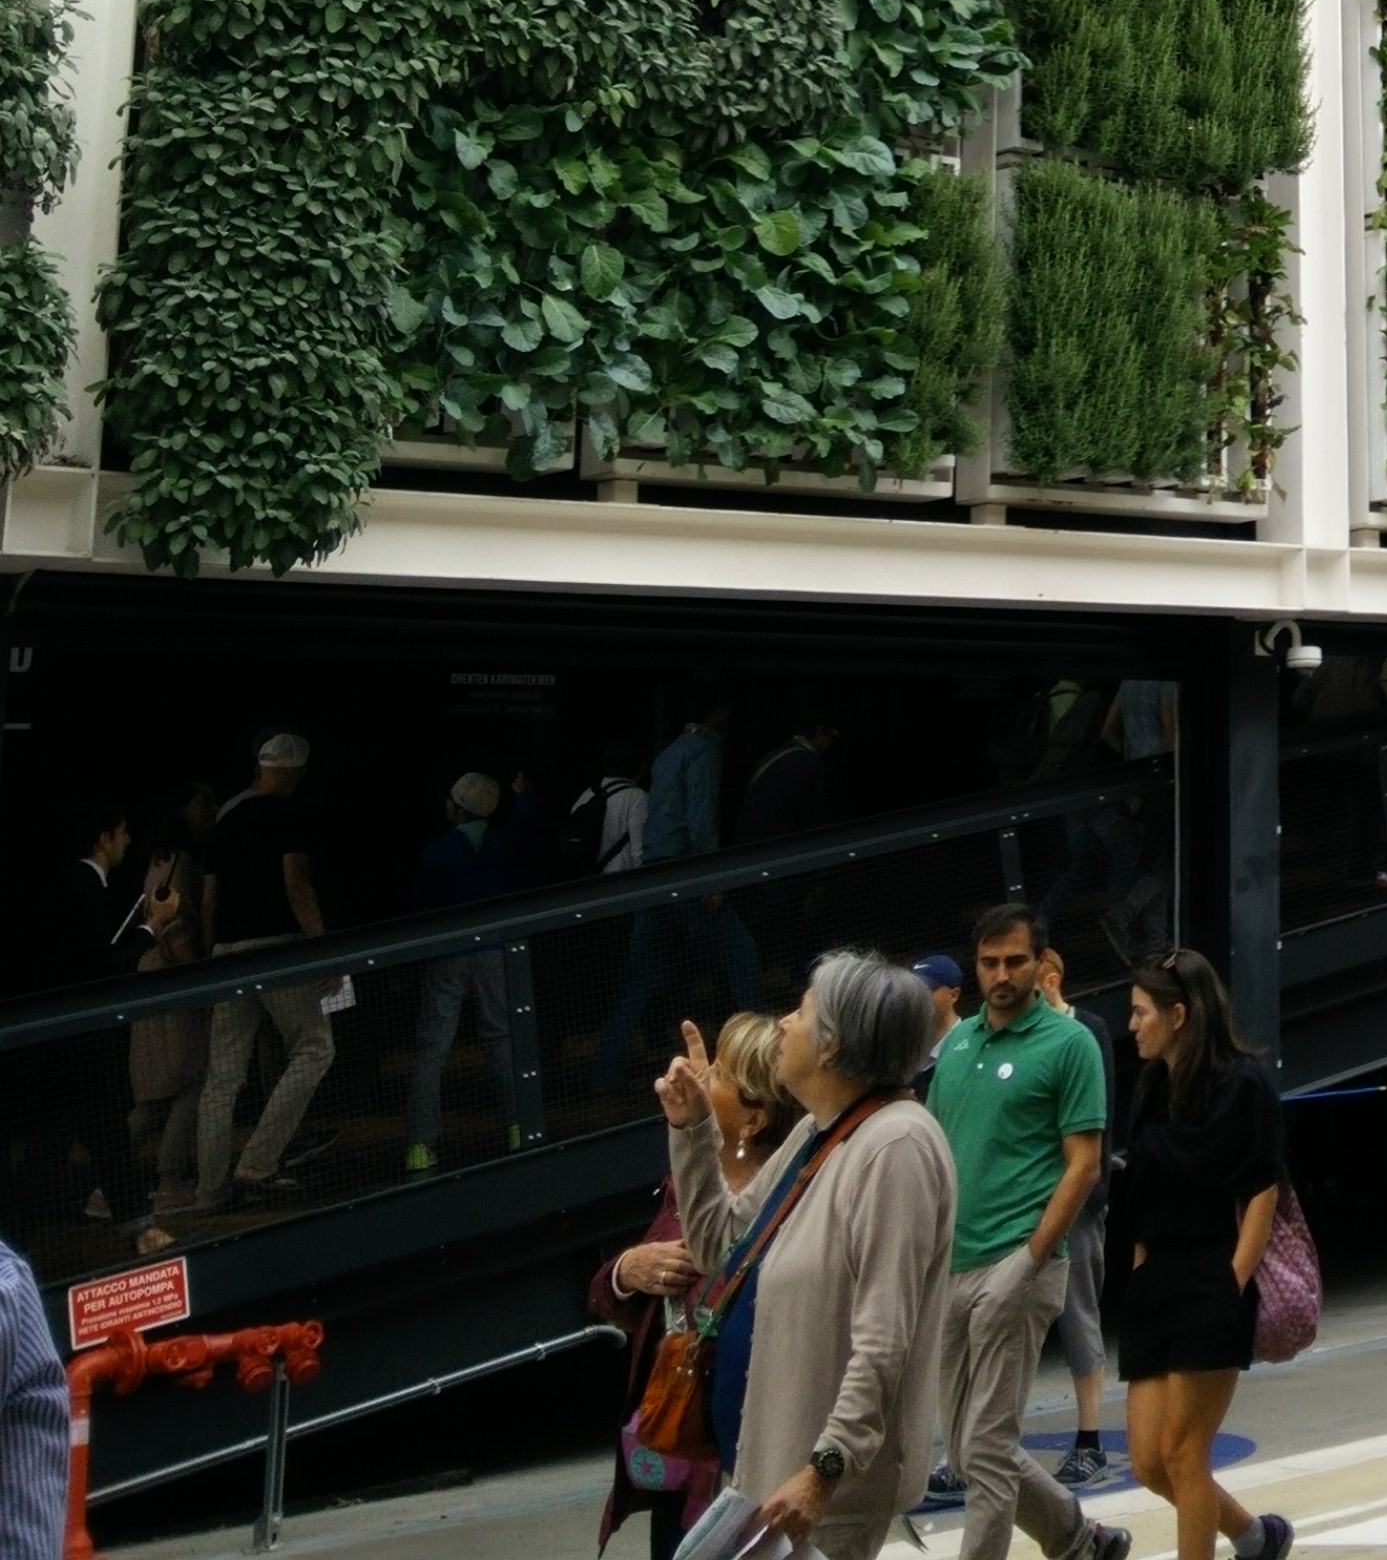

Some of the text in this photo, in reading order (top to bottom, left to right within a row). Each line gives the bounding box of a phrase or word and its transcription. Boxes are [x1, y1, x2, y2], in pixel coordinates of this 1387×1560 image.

[77, 1266, 179, 1302] ATTACCO MANDATA
[83, 1281, 175, 1314] PER AUTOPOMPA
